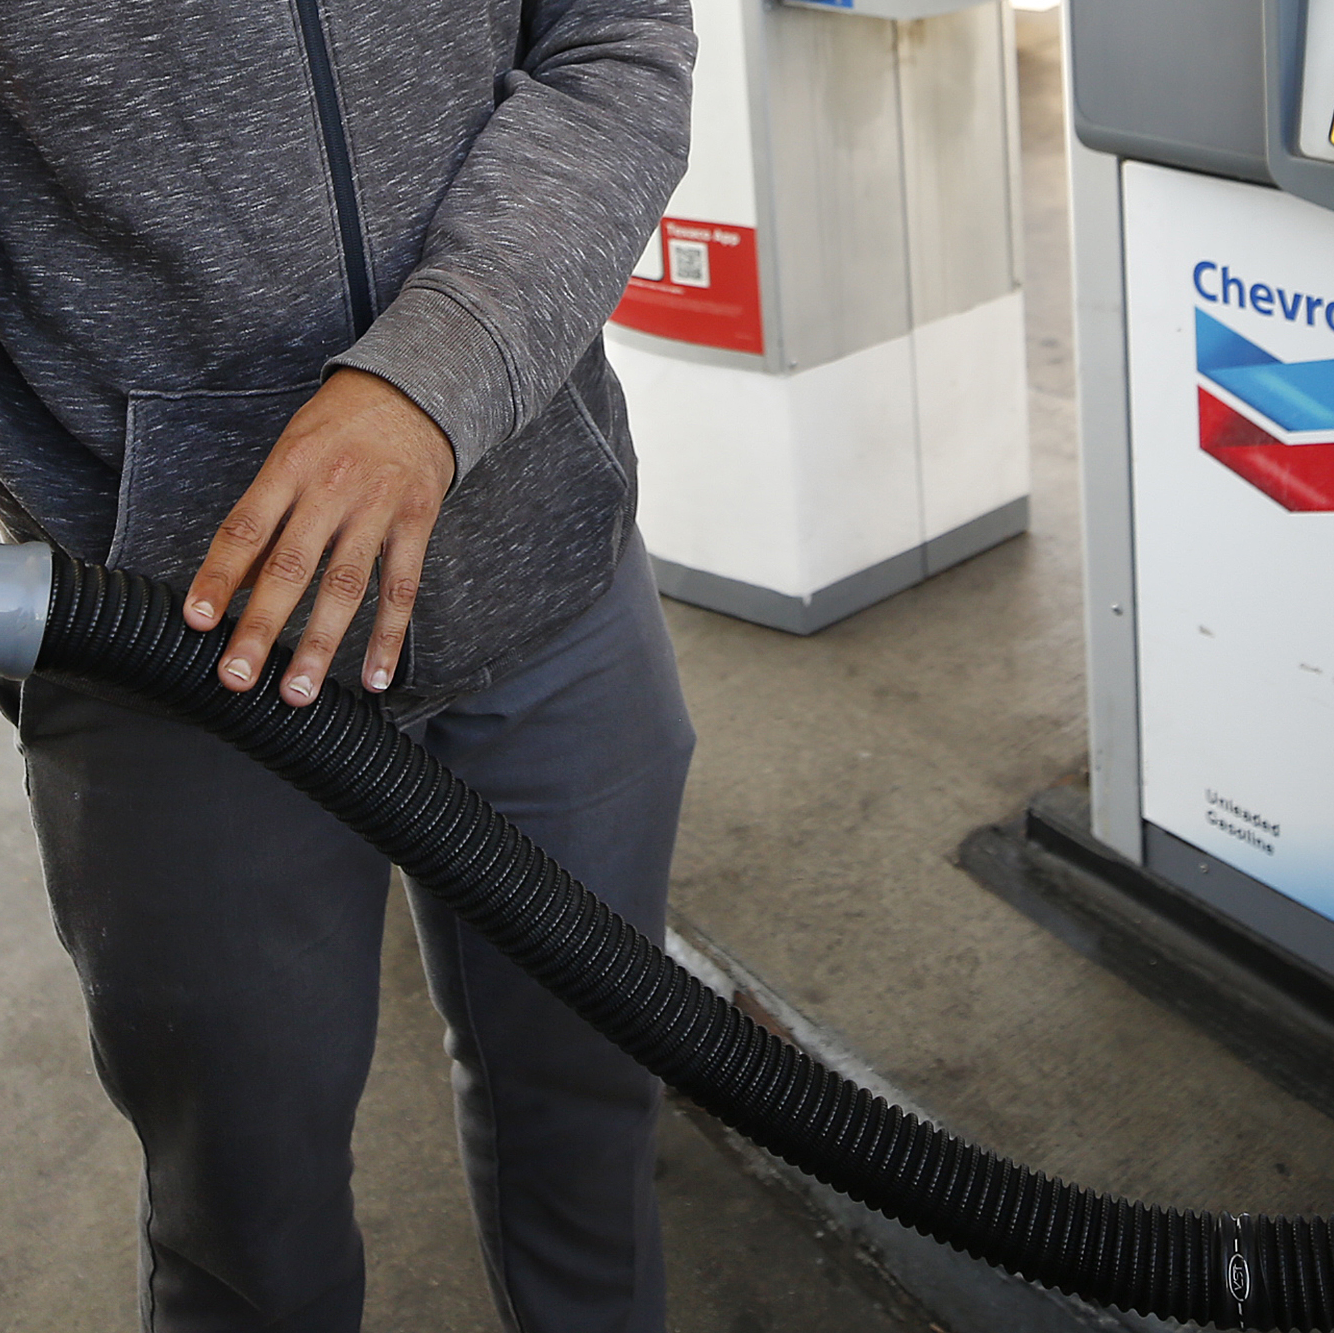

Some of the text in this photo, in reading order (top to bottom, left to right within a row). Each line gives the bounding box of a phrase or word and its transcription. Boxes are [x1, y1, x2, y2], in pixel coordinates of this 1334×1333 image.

[714, 229, 740, 246] App
[1205, 788, 1280, 838] Unleaded
[1207, 810, 1275, 856] Gasoline
[1233, 1264, 1244, 1291] VST
